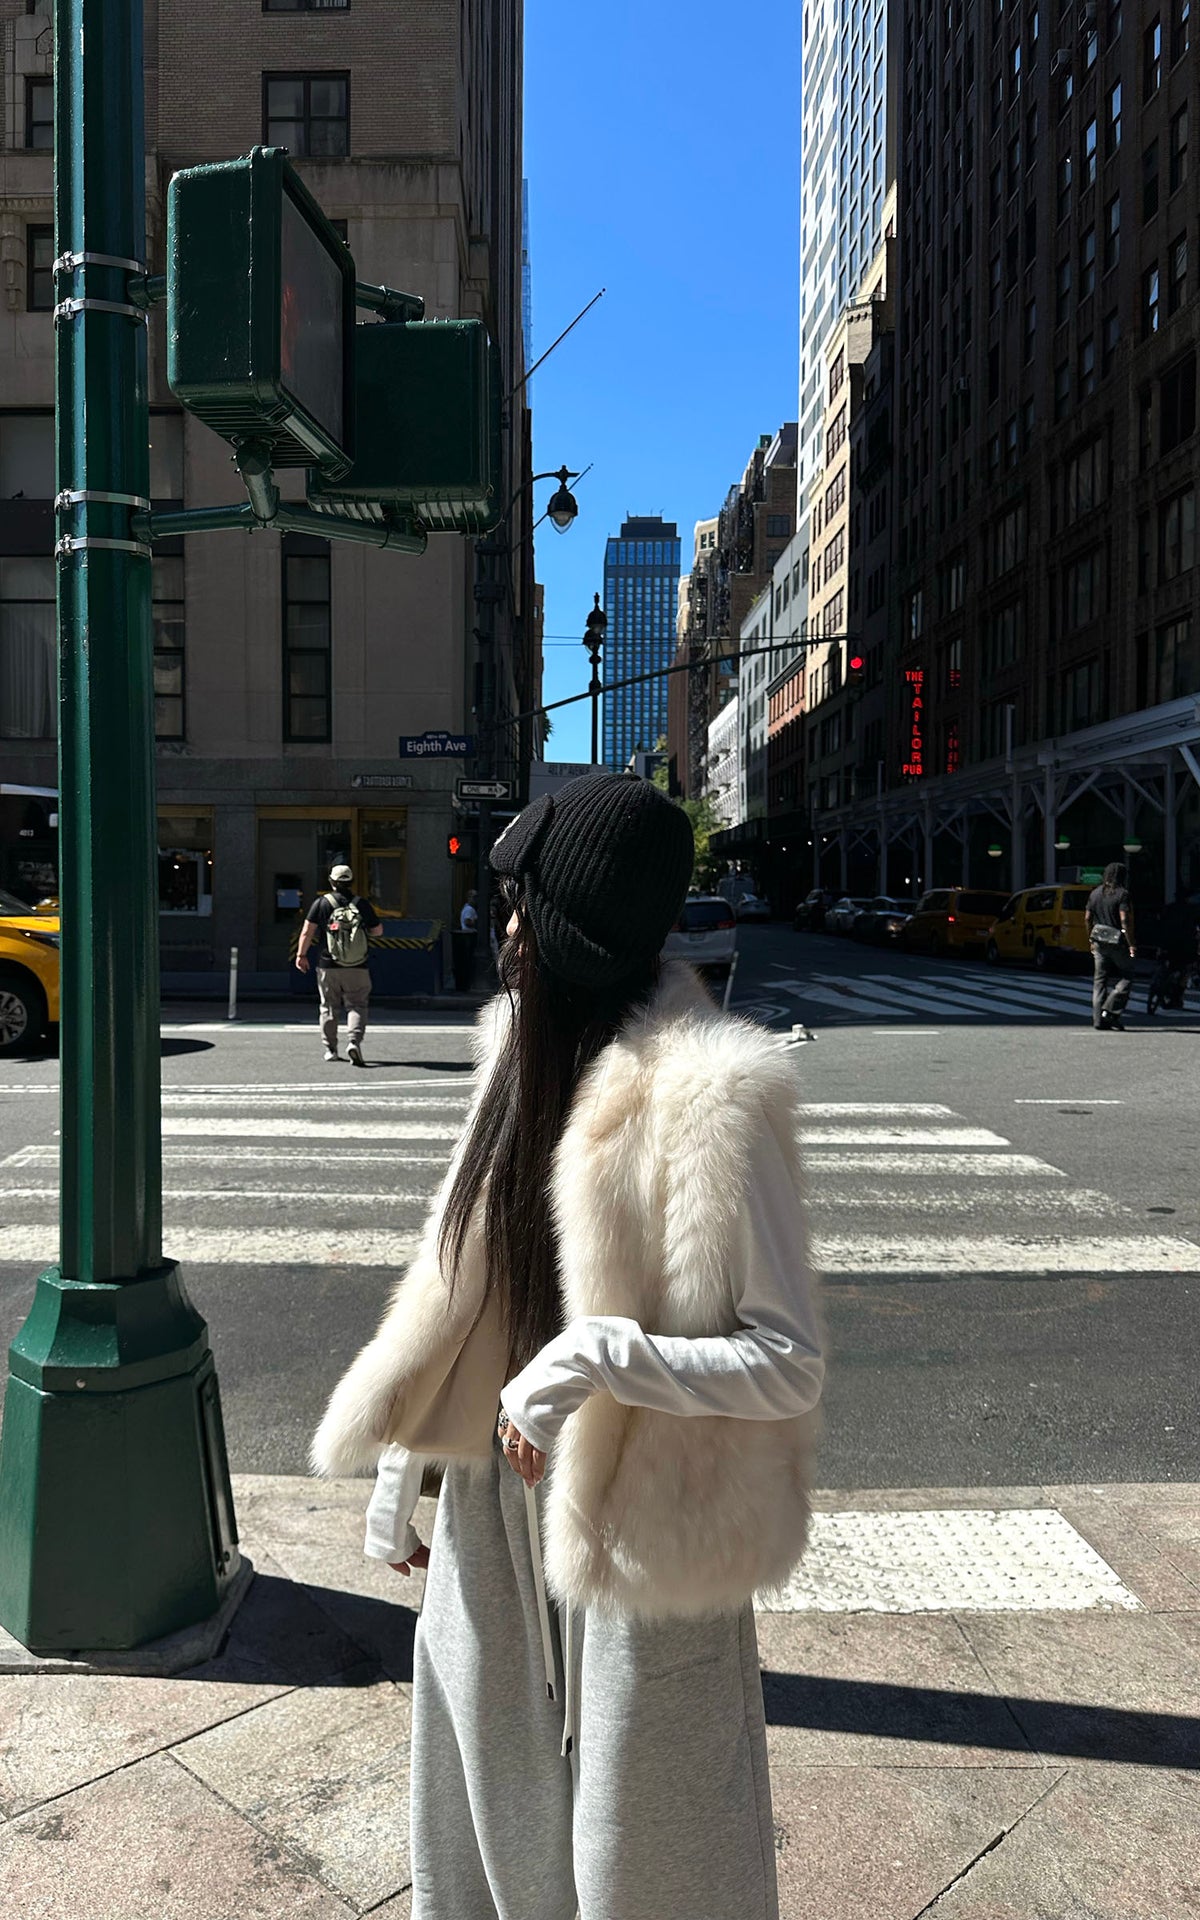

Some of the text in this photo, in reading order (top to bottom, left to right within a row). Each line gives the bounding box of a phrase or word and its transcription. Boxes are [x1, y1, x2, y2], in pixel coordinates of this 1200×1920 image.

[905, 671, 924, 682] THE
[912, 683, 923, 763] TAILOR
[406, 740, 467, 755] Eighth Ave
[902, 764, 923, 775] PUB
[487, 786, 503, 794] WAY
